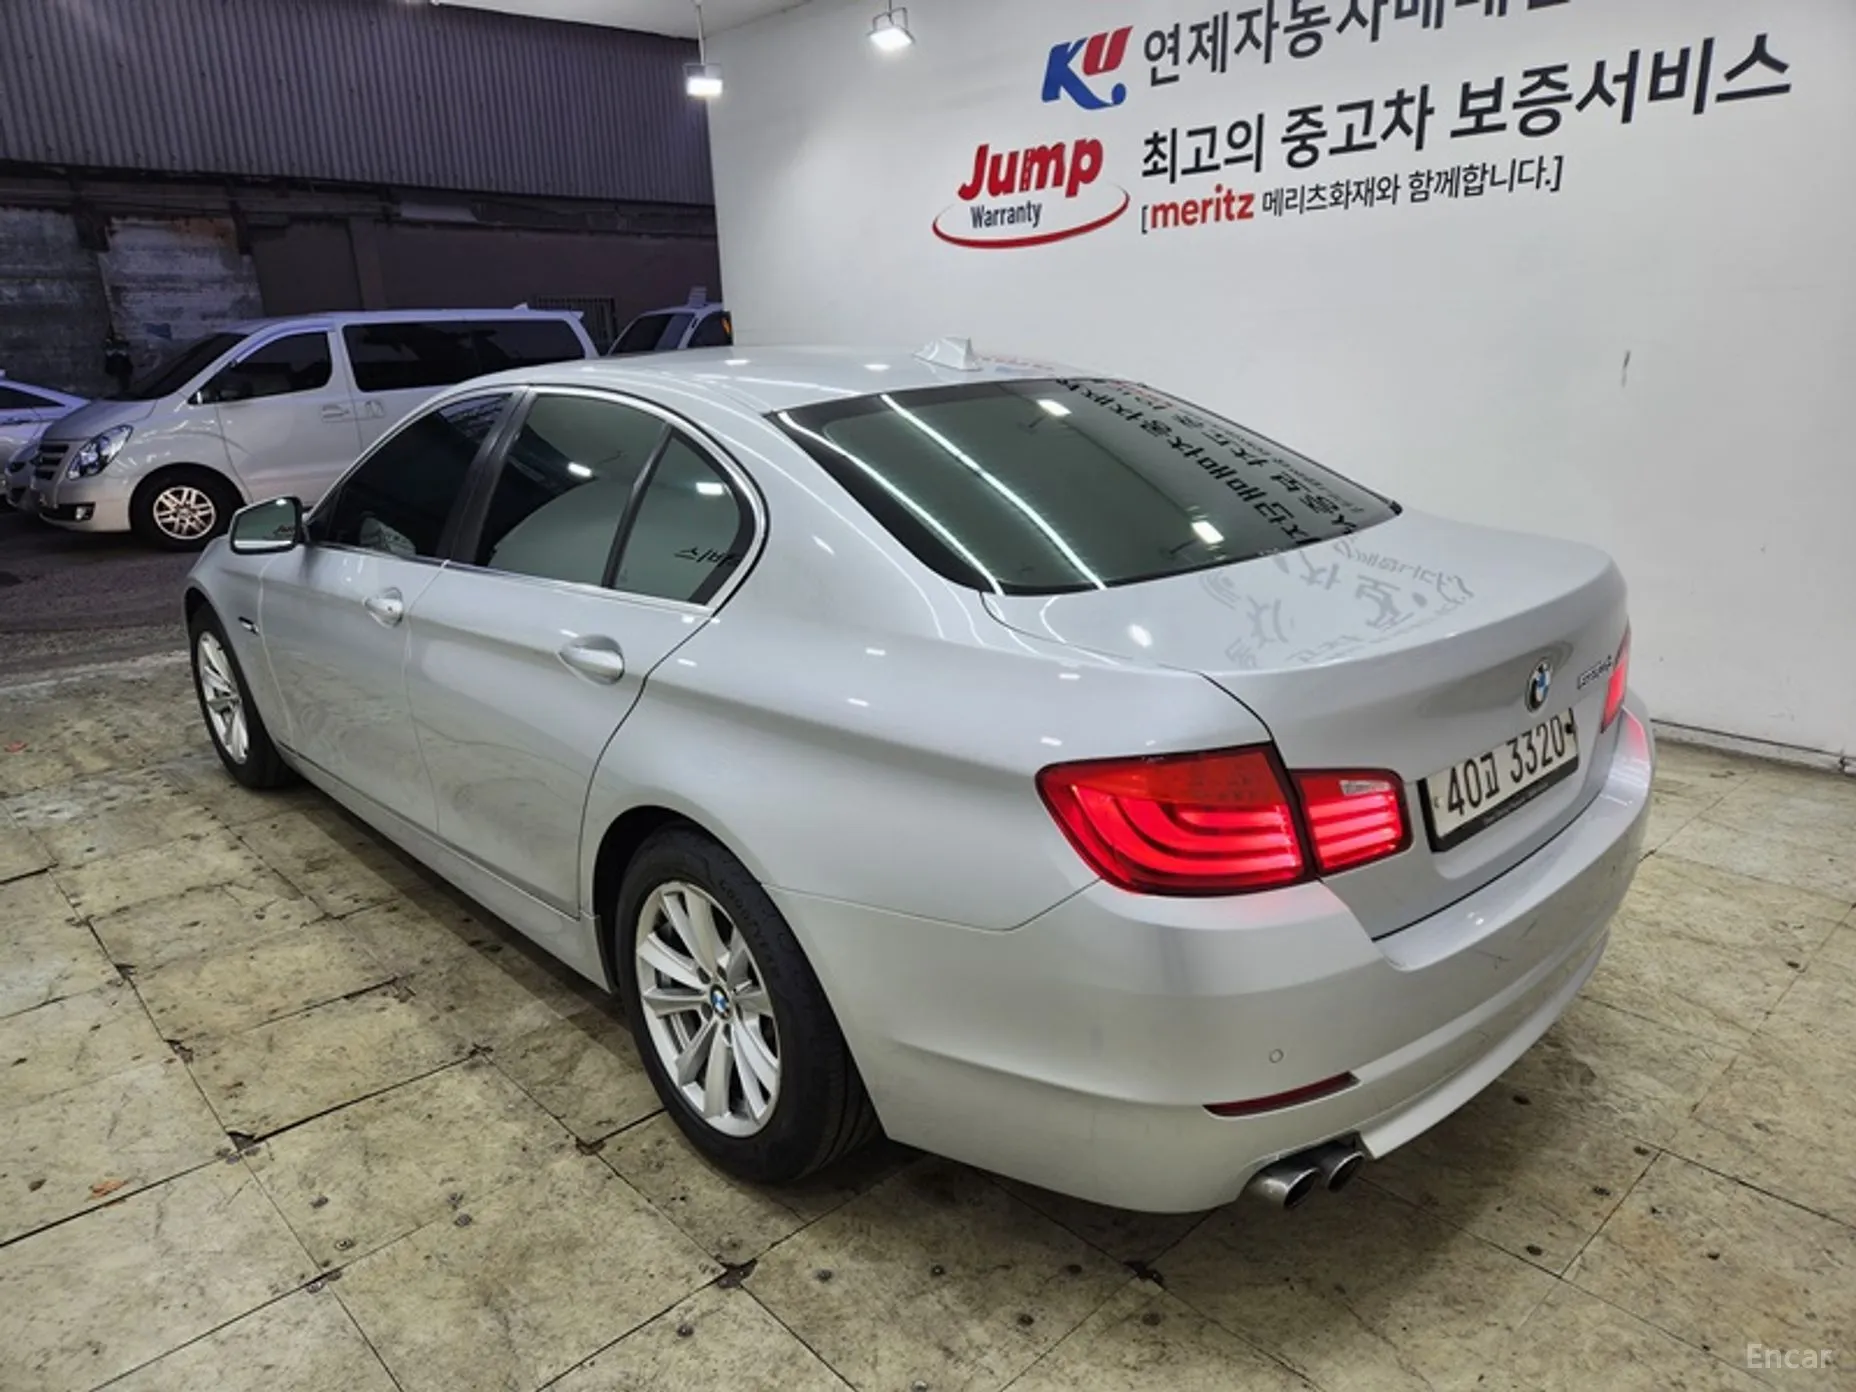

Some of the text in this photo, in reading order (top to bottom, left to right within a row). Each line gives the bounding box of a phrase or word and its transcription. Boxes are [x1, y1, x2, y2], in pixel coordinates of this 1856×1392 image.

[1143, 0, 1571, 87] 연제자동차
[1141, 33, 1792, 184] 최고의 중고차 보증서비스
[957, 137, 1104, 201] Jump
[1262, 174, 1402, 217] 메리츠화재와
[1408, 155, 1564, 203] 함께합니다.]
[970, 200, 1043, 229] Warranty
[1506, 714, 1566, 784] 3320
